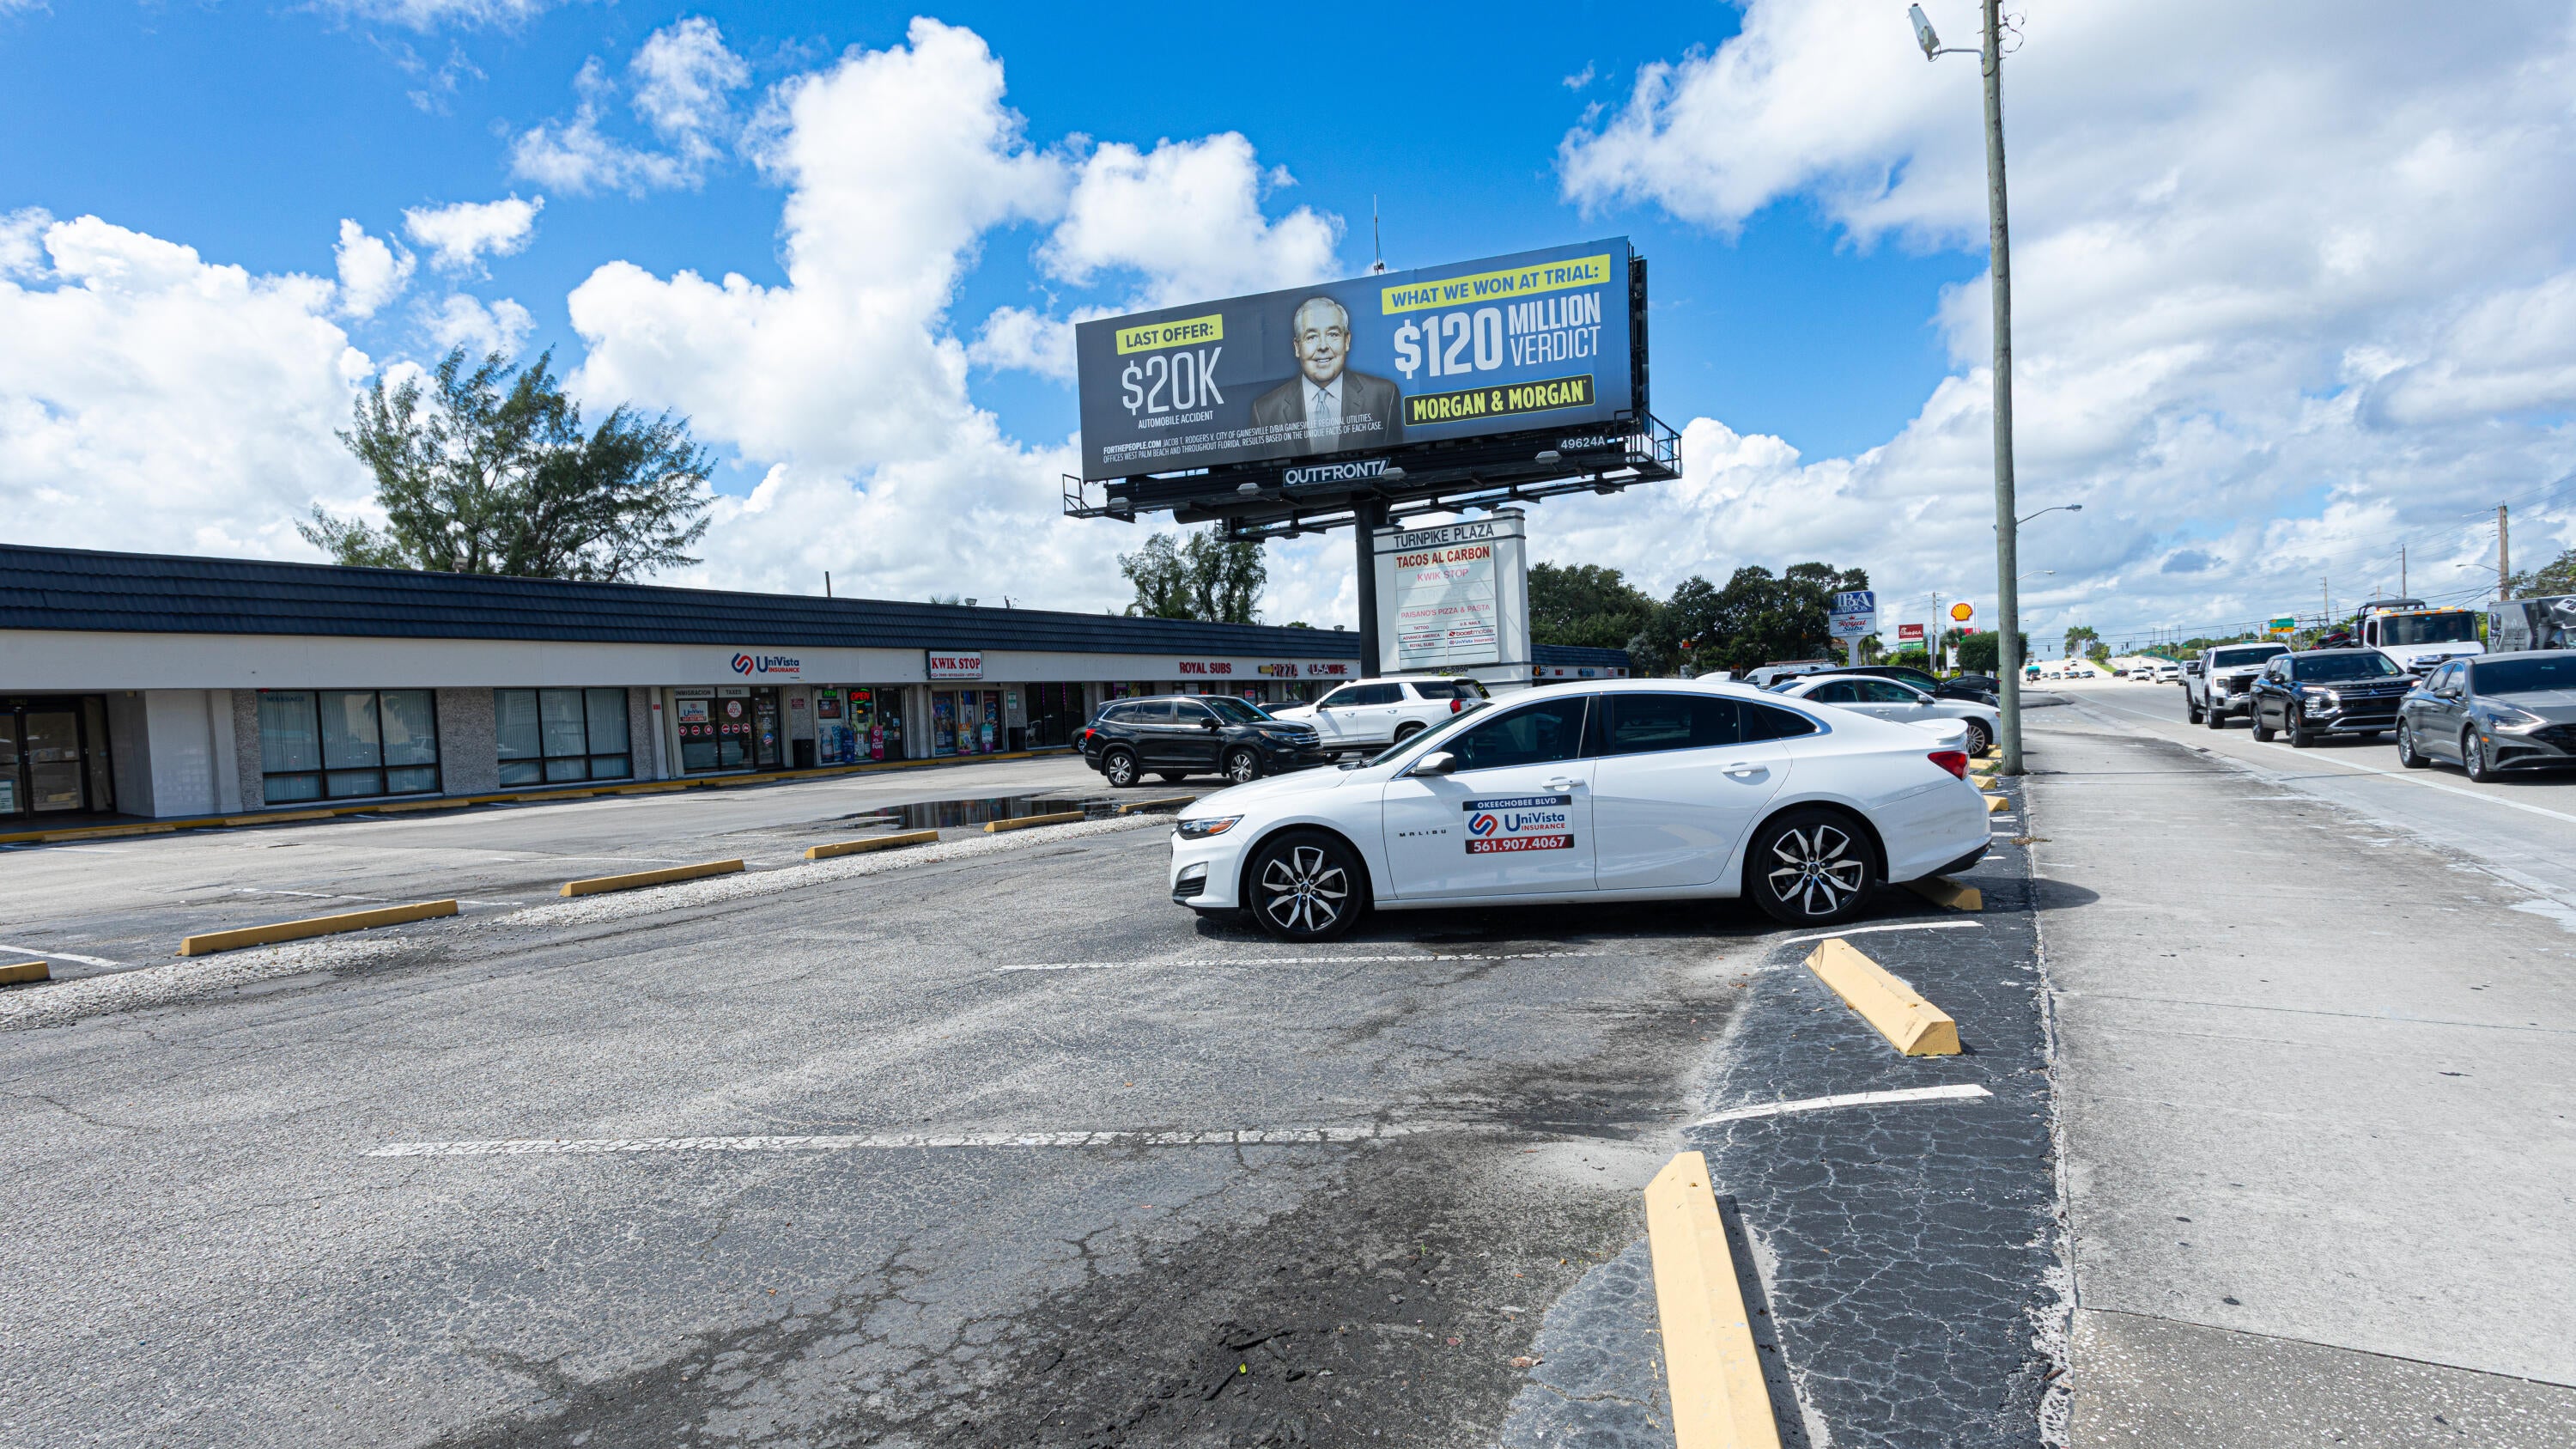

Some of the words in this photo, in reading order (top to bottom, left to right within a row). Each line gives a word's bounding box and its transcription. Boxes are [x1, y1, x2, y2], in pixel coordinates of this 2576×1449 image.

[1392, 285, 1438, 307] WHAT
[1443, 283, 1468, 299] WE
[1473, 276, 1515, 295] WON
[1519, 272, 1540, 289] AT
[1544, 265, 1599, 285] TRIAL:
[1508, 291, 1601, 336] MILLION
[1126, 330, 1158, 347] LAST
[1163, 323, 1213, 342] OFFER:
[1394, 307, 1504, 380] $120
[1510, 326, 1601, 367] VERDICT
[1121, 346, 1224, 416] $20K
[1413, 392, 1485, 421] MORGAN
[1491, 390, 1504, 412] &
[1509, 381, 1583, 408] MORGAN
[1139, 415, 1180, 429] AUTOMOBILE
[1181, 411, 1214, 423] ACCIDENT
[1103, 440, 1162, 455] FORTHEPEOPLE.COM
[1162, 437, 1179, 447] JACOB
[1185, 434, 1210, 444] RODGERS
[1216, 431, 1228, 440] CITY
[1236, 426, 1269, 438] GAINESVILLE
[1270, 424, 1284, 433] D/B/A
[1285, 420, 1316, 431] GAINESVILLE
[1318, 417, 1345, 427] REGIONAL
[1346, 413, 1373, 424] UTILITIES.
[1103, 453, 1123, 464] OFFICES
[1124, 452, 1137, 460] WEST
[1139, 450, 1151, 459] PALM
[1153, 448, 1169, 457] BEACH
[1170, 447, 1181, 455] AND
[1182, 441, 1217, 453] THROUGHOUT
[1218, 439, 1241, 449] FLORIDA.
[1242, 436, 1265, 446] RESULTS
[1266, 434, 1282, 443] BASED
[1284, 432, 1291, 441] ON
[1293, 430, 1303, 440] THE
[1304, 429, 1326, 438] UNIQUE
[1326, 426, 1342, 435] FACTS
[1343, 425, 1351, 434] OF
[1352, 423, 1366, 433] EACH
[1367, 421, 1383, 431] CASE.
[1560, 435, 1606, 449] 49624A
[1394, 528, 1449, 548] TURNPIKE
[1455, 523, 1494, 540] PLAZA
[1397, 554, 1429, 568] TACOS
[1431, 551, 1444, 563] AL
[1447, 545, 1490, 562] CARBON
[1417, 573, 1441, 581] KWIK
[1443, 569, 1469, 578] STOP
[1400, 609, 1437, 618] PAISANO'S
[1438, 606, 1458, 615] PIZZA
[756, 656, 799, 673] UniVista
[932, 658, 957, 669] KWIK
[959, 658, 981, 669] STOP
[1179, 661, 1207, 674] ROYAL
[1209, 661, 1231, 674] SUBS
[850, 691, 870, 701] OPEN
[1477, 799, 1533, 809] OKEECHOBEE
[1534, 797, 1557, 806] BLVD
[1504, 813, 1565, 832] UniVista
[1521, 823, 1565, 831] INSURANCE
[1400, 829, 1447, 837] MALIBU
[1473, 837, 1566, 853] 561.907.4067
